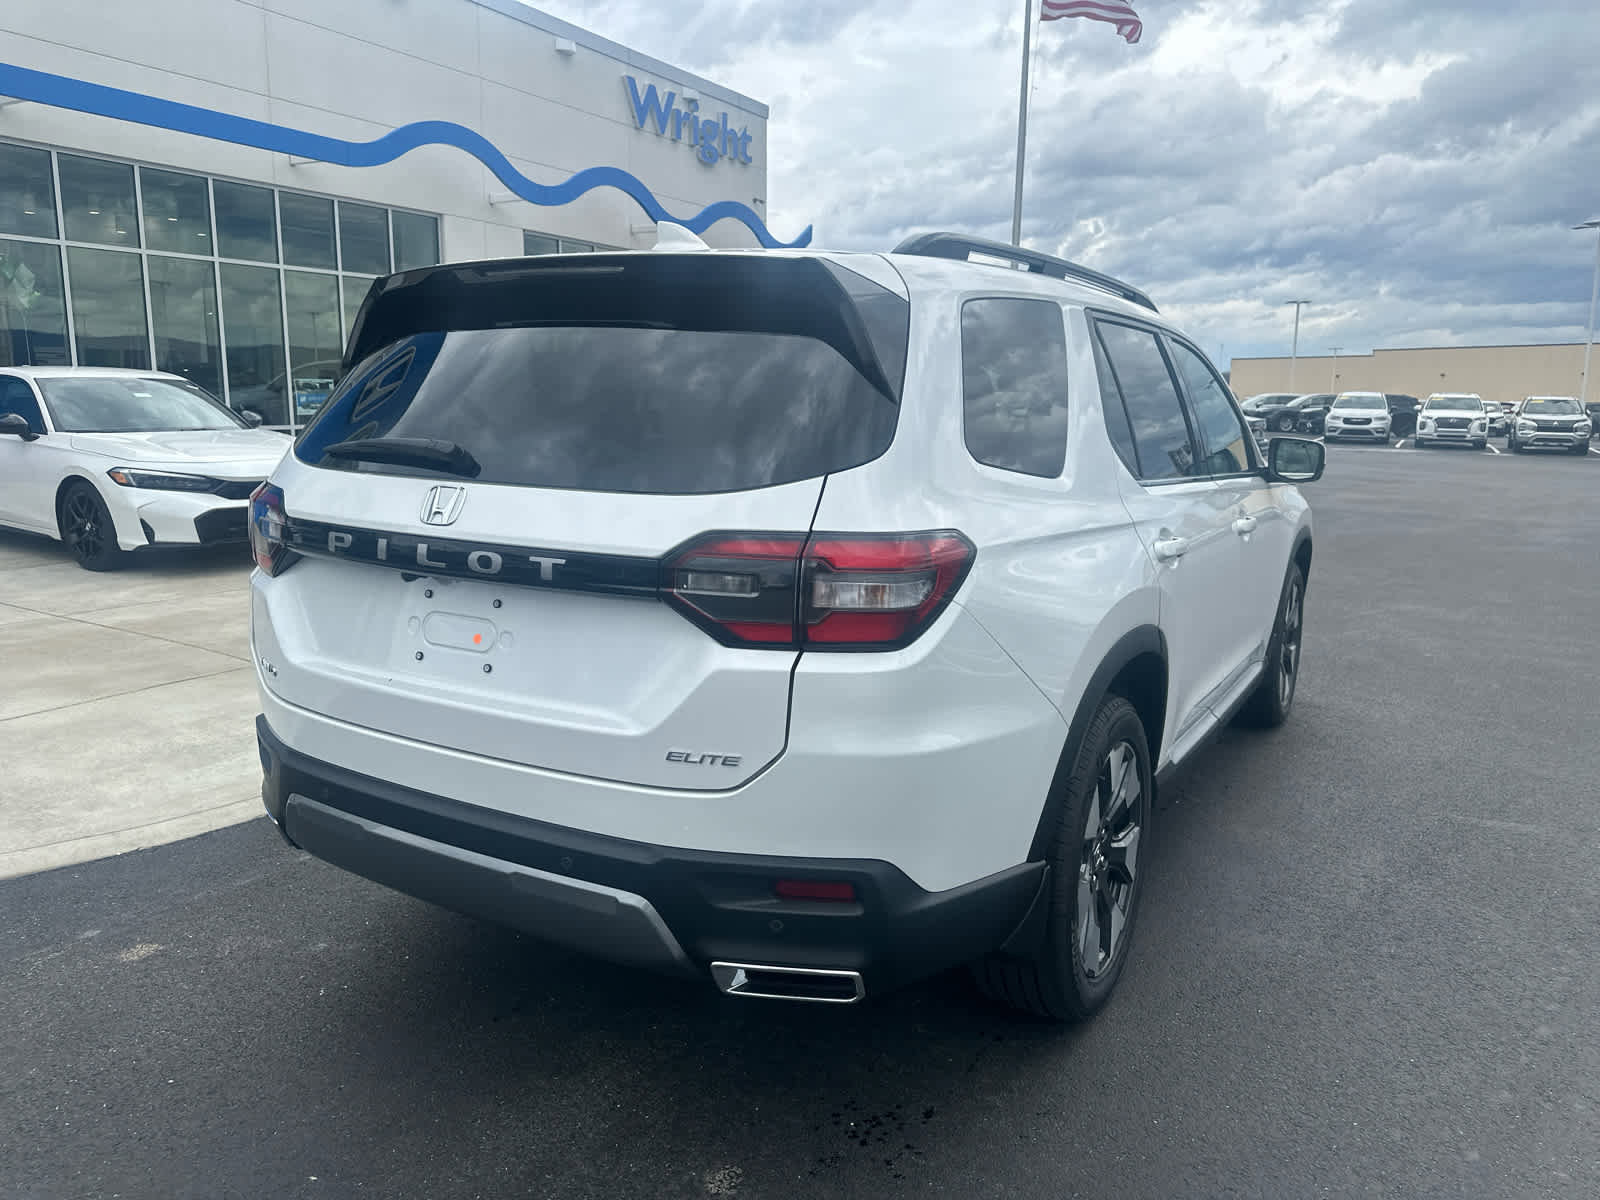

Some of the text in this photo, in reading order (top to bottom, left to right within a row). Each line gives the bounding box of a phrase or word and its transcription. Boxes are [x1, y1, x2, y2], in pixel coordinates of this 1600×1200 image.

[623, 75, 752, 164] Wright
[328, 531, 566, 581] PILOT
[665, 751, 742, 767] ELITE
